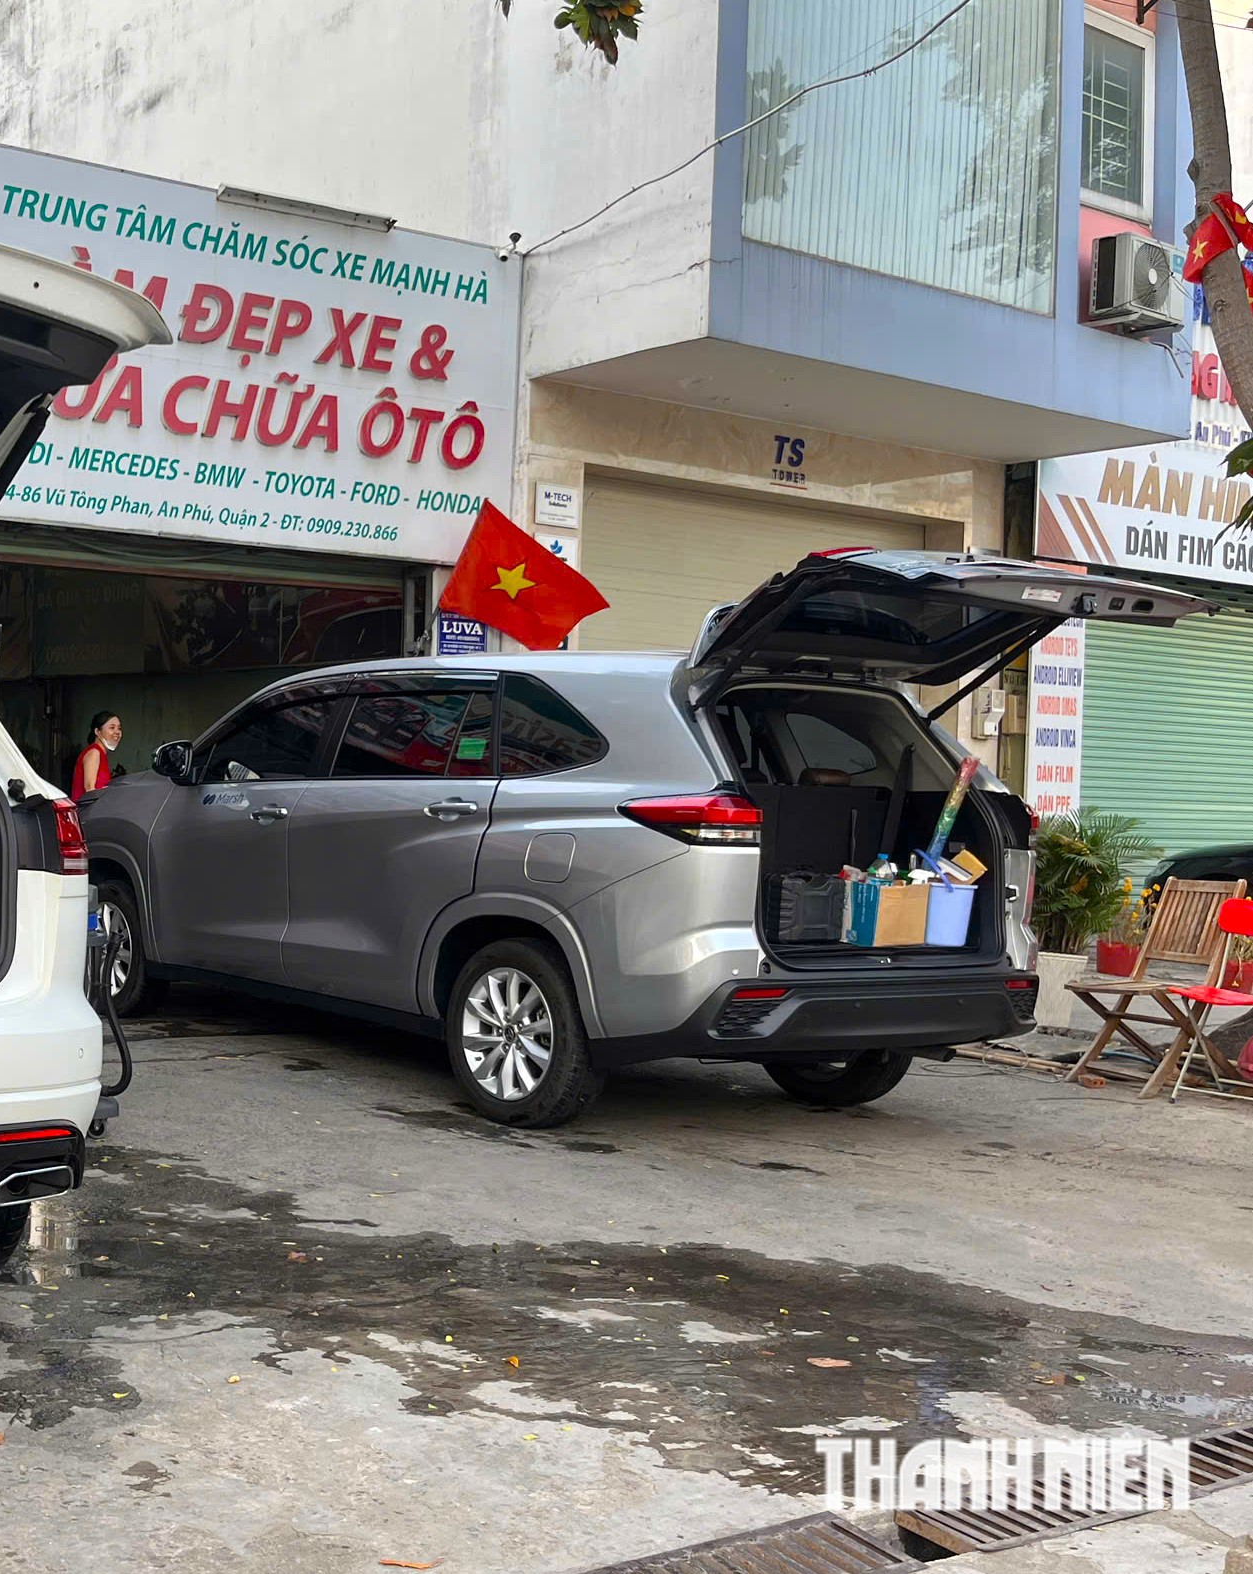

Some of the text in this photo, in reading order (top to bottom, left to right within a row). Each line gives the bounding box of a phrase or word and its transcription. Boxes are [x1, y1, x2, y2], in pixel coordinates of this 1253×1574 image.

[3, 185, 488, 304] TRUNG TÂM CHĂM SÓC XE MẠNH HÀ
[177, 283, 455, 381] ĐẸP XE &
[161, 371, 338, 453] CHỮA
[357, 387, 486, 470] ÔTÔ
[774, 435, 805, 467] TS
[68, 446, 180, 481] MERCEDES
[193, 462, 246, 489] BMW
[264, 470, 336, 500] TOYOTA
[350, 481, 401, 506] FORD
[416, 489, 482, 515] HONDA
[772, 468, 806, 485] TOWER
[1097, 450, 1194, 517] MÀN
[45, 487, 66, 506] Vũ
[70, 490, 108, 515] Tông
[110, 495, 153, 517] Phan,
[157, 500, 179, 519] An
[182, 503, 215, 525] Phú,
[219, 507, 257, 531] Quận
[259, 512, 270, 528] 2
[280, 514, 304, 533] ĐT:
[307, 517, 399, 542] 0909.230.866
[544, 491, 572, 503] M-TECH
[1125, 520, 1168, 560] DÁN
[1177, 533, 1213, 567] FIM
[442, 621, 483, 635] LUVA
[1035, 727, 1059, 748] ANDROID
[1055, 765, 1074, 783] FILM
[217, 792, 245, 805] Marsh
